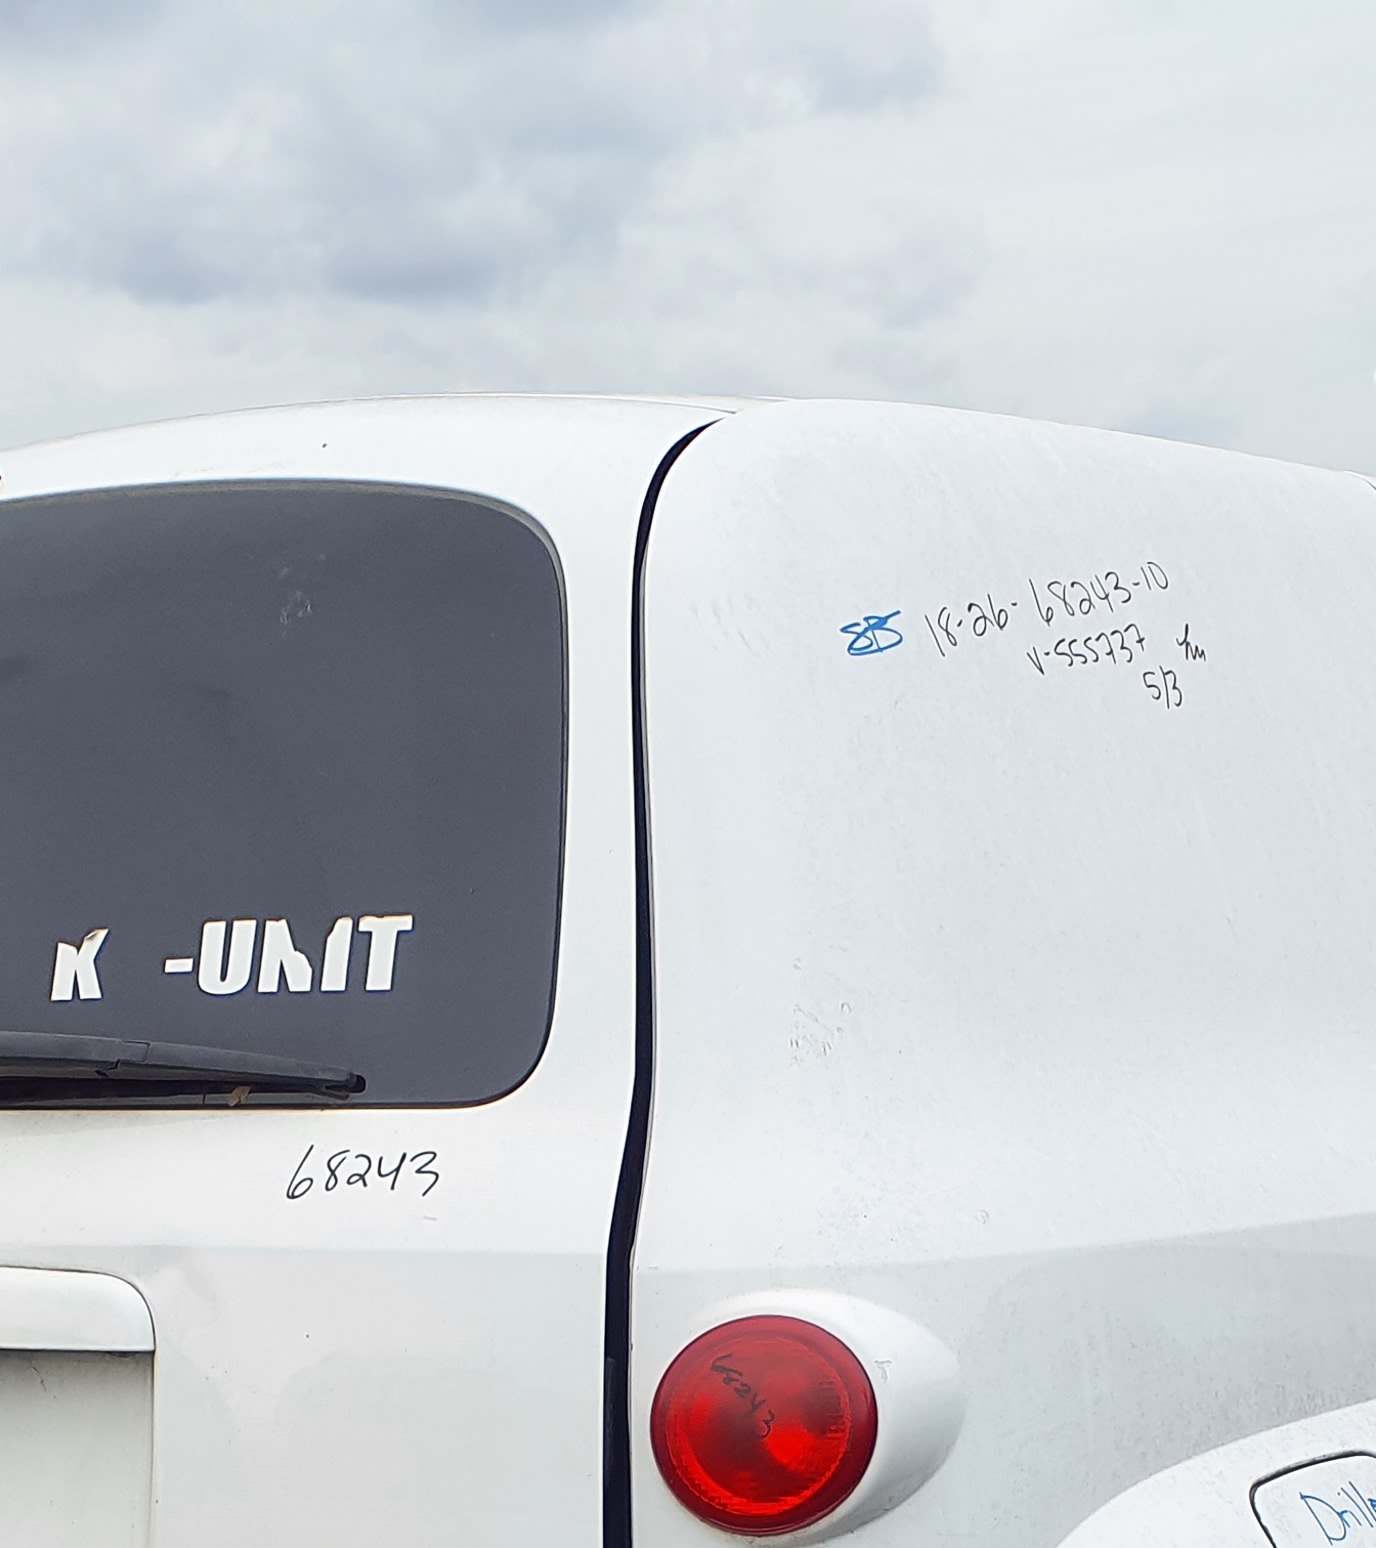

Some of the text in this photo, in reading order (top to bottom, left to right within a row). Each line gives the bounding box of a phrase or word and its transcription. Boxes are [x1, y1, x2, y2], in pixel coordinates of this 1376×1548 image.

[1143, 665, 1183, 710] 5/3
[50, 928, 110, 1001] K
[285, 1144, 440, 1201] 68243
